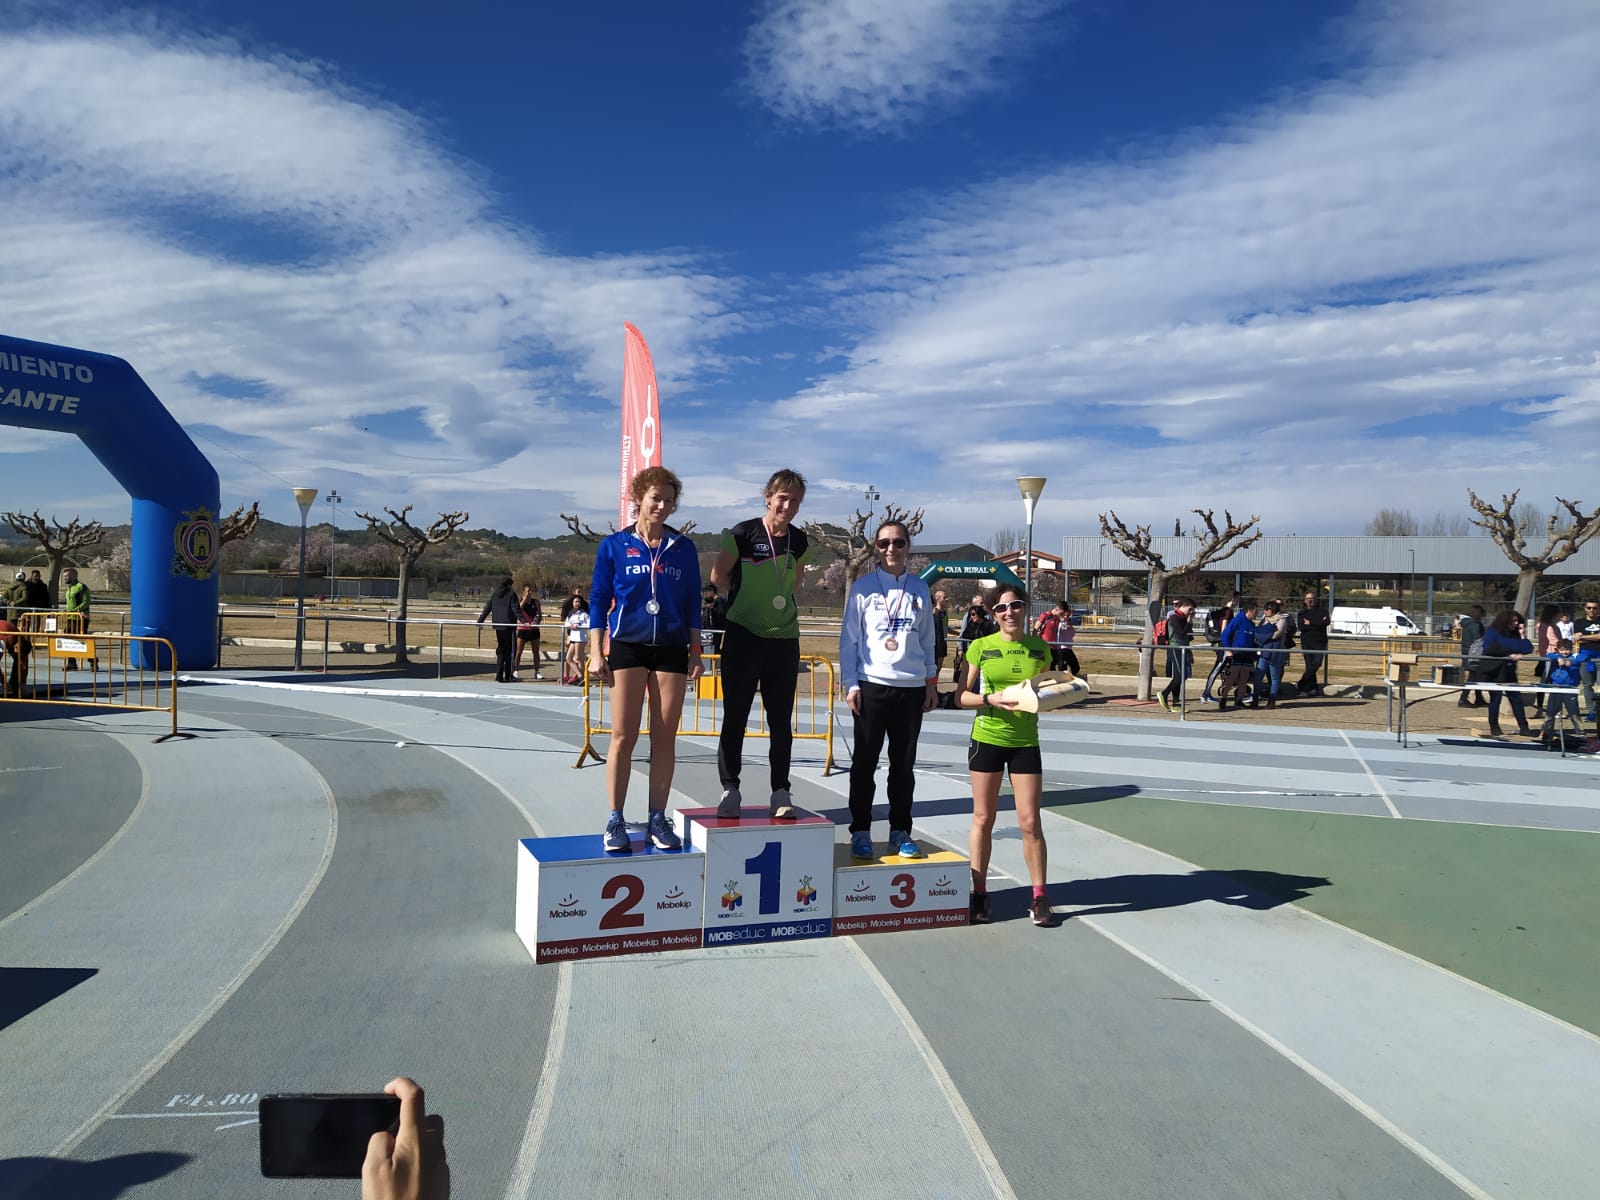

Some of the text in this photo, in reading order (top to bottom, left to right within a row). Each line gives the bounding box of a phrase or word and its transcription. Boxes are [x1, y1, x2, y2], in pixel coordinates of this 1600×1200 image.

[0, 386, 80, 415] ANTE
[944, 566, 989, 574] CAJA RURAL
[745, 842, 782, 915] 1
[845, 893, 877, 903] Mobekip
[889, 873, 916, 909] 3
[928, 887, 958, 897] Mobekip
[599, 874, 645, 930] 2
[656, 899, 692, 910] Mobekip
[549, 908, 587, 919] Mobekip
[836, 911, 965, 930] Mobekip Mobekip Mobekip Mobekip
[708, 922, 827, 943] MOBeduc MOBeduc
[540, 934, 698, 957] Mobekip Mobekip Mobekip Mobekip
